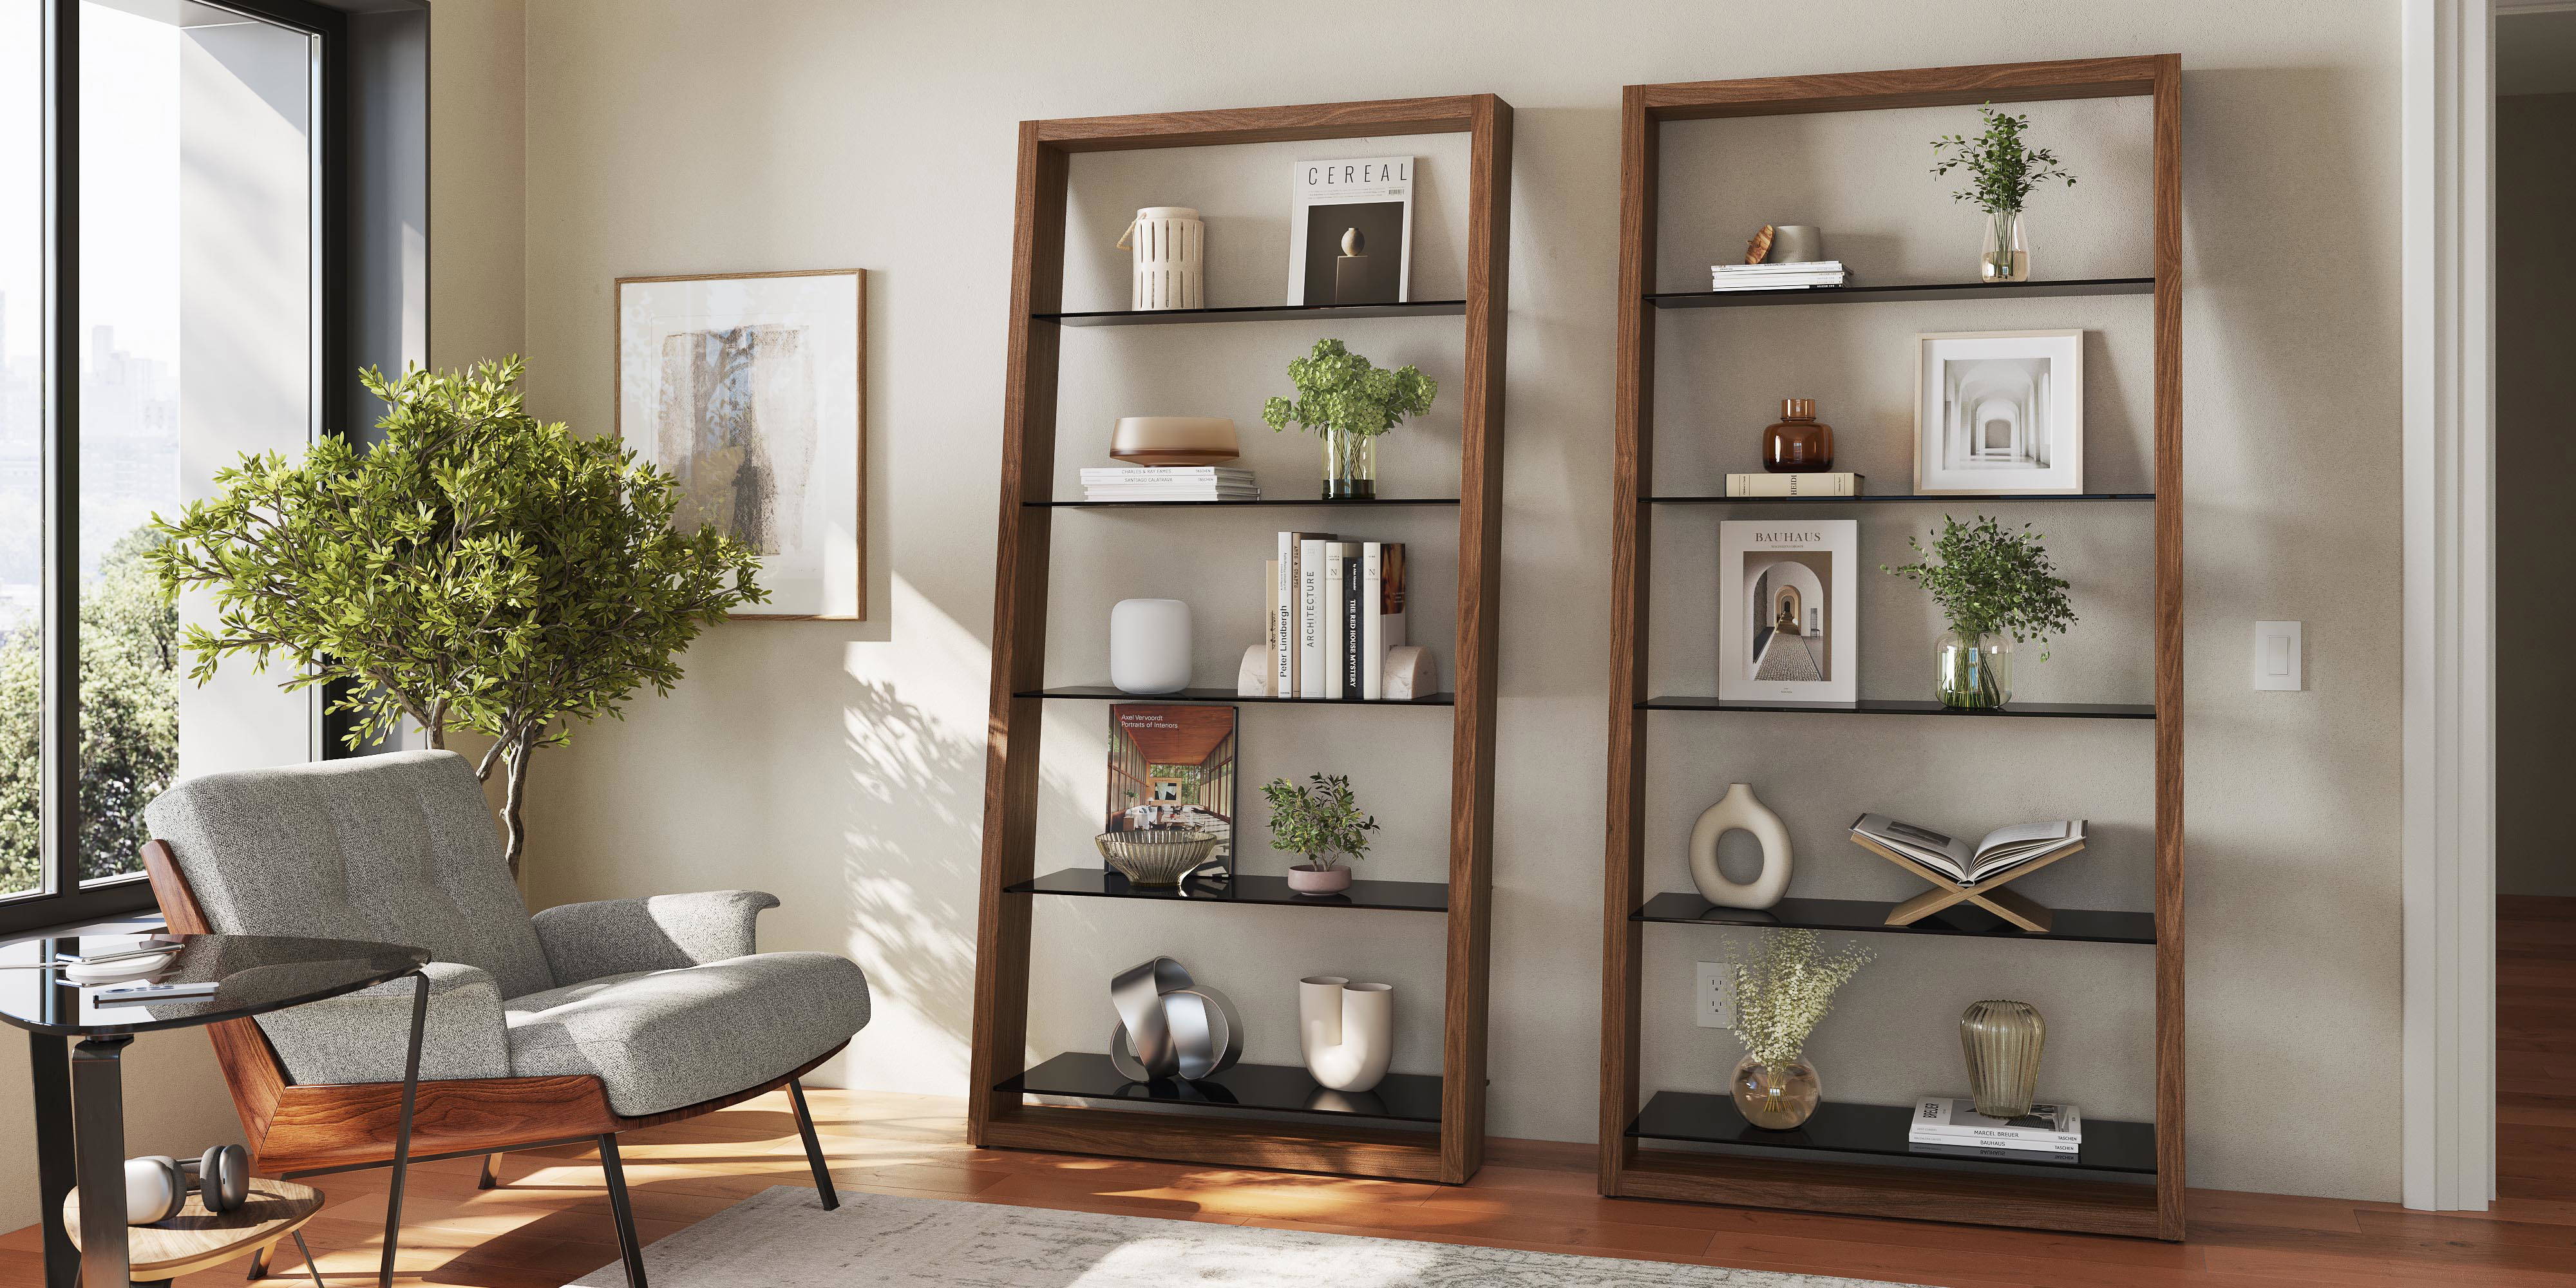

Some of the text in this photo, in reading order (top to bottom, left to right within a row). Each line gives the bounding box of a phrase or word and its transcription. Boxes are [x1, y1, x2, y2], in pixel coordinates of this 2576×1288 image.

[1309, 163, 1407, 185] CEREAL
[1756, 533, 1821, 542] BAUHAUS
[1280, 605, 1289, 651] Lindbergh
[1923, 1103, 1939, 1118] BREUER
